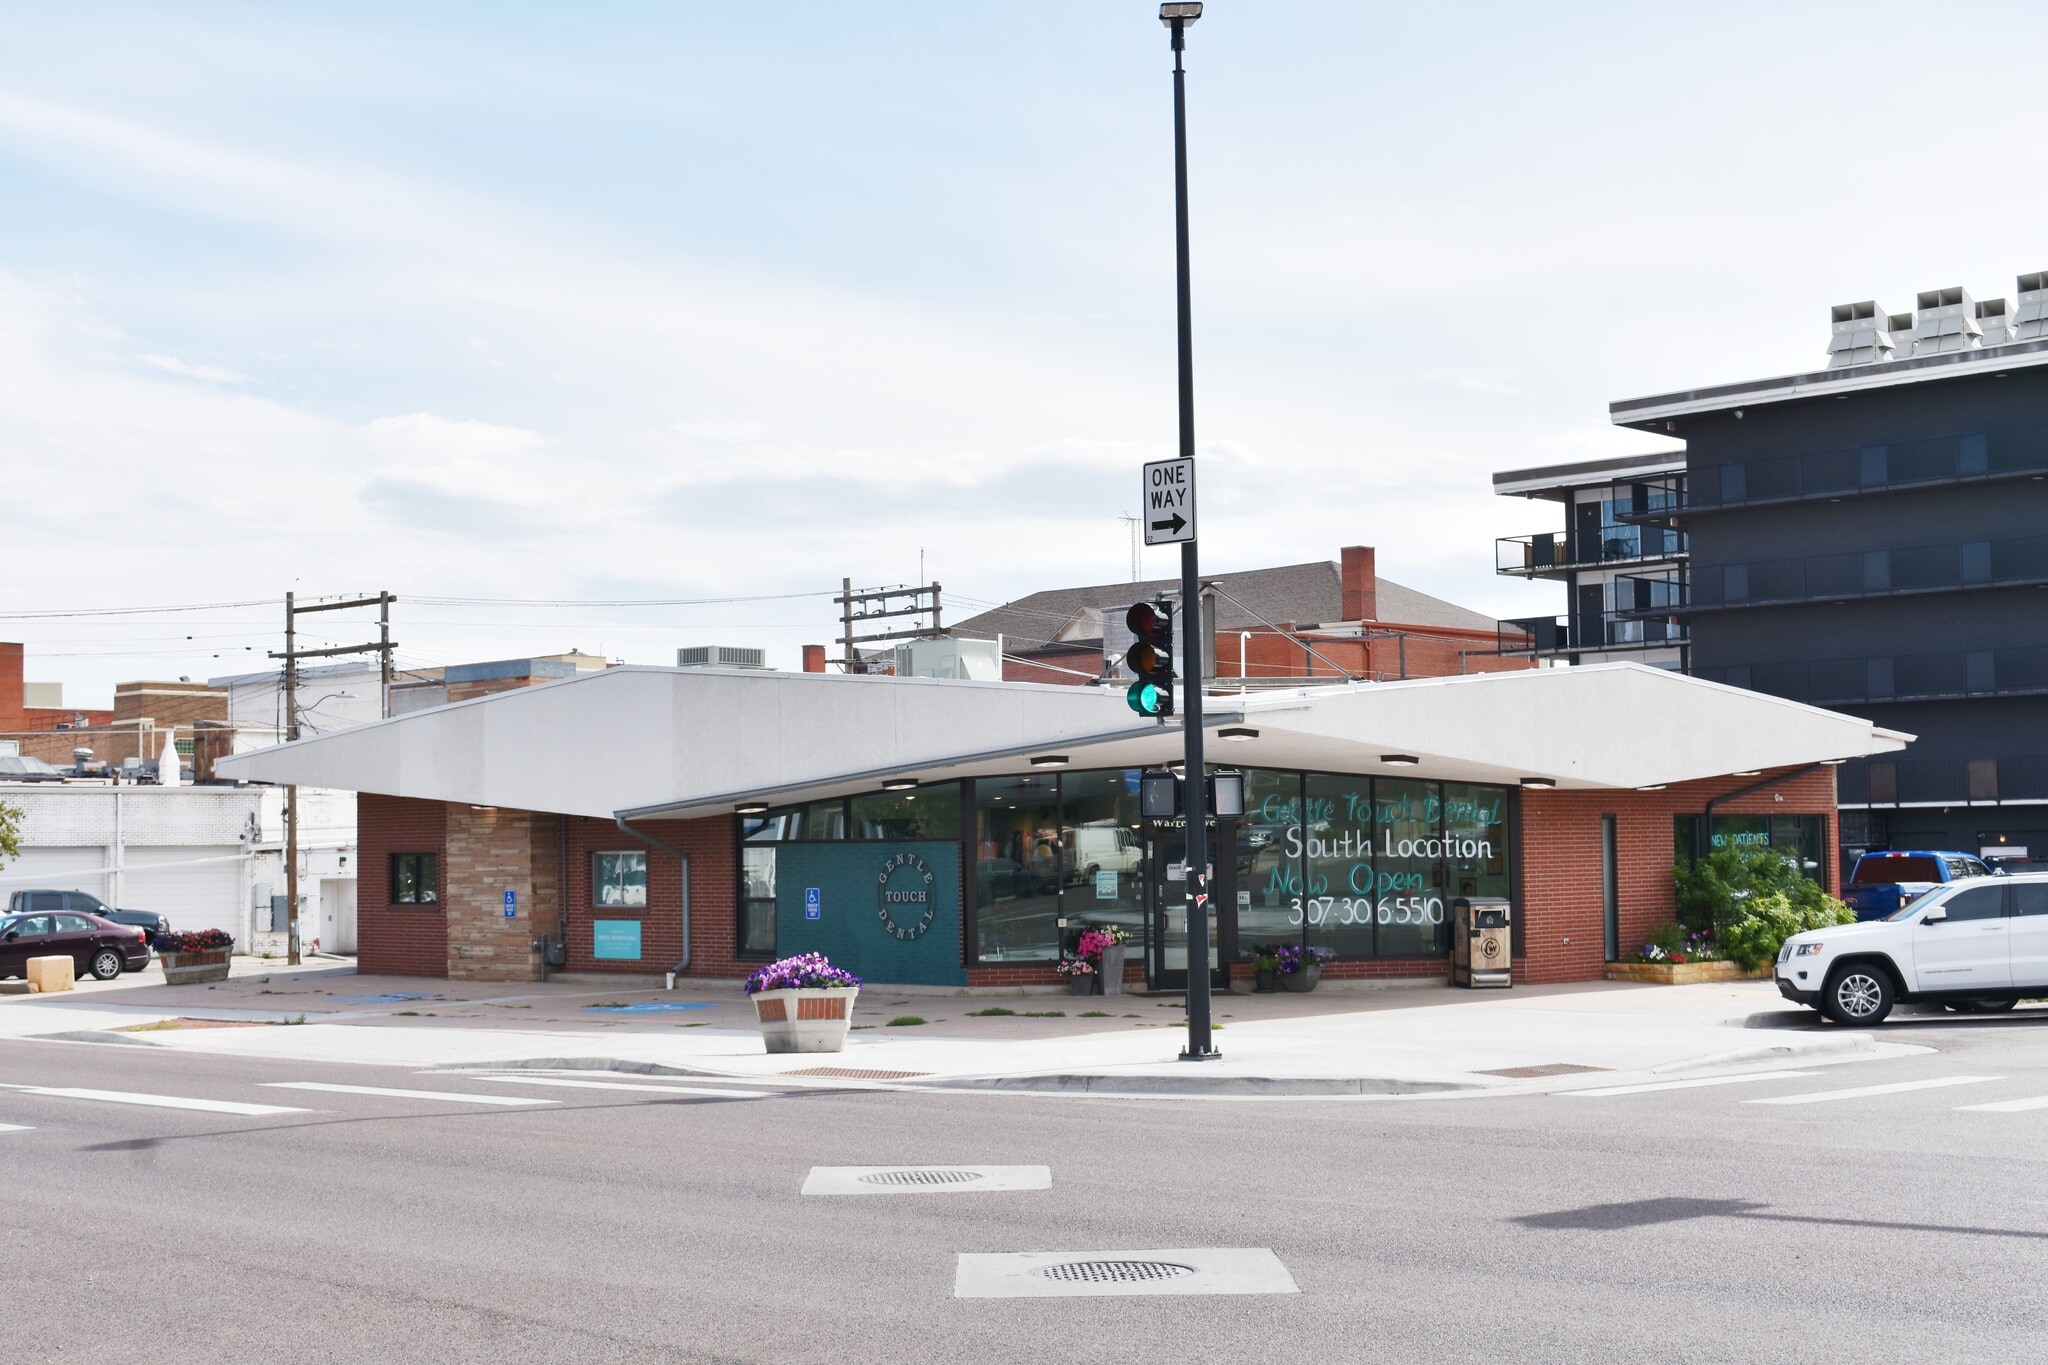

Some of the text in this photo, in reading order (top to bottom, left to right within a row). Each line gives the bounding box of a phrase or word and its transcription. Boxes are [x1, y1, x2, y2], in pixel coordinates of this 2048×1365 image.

[1152, 466, 1185, 486] ONE
[1151, 488, 1186, 509] WAY
[1152, 819, 1187, 827] Warre
[1260, 791, 1503, 825] Gentle Touch Dental
[1284, 826, 1494, 859] South Location
[879, 853, 933, 884] GENTLE
[1262, 863, 1426, 898] Now Open
[885, 891, 927, 902] TOUCH
[879, 907, 933, 940] DENTAL
